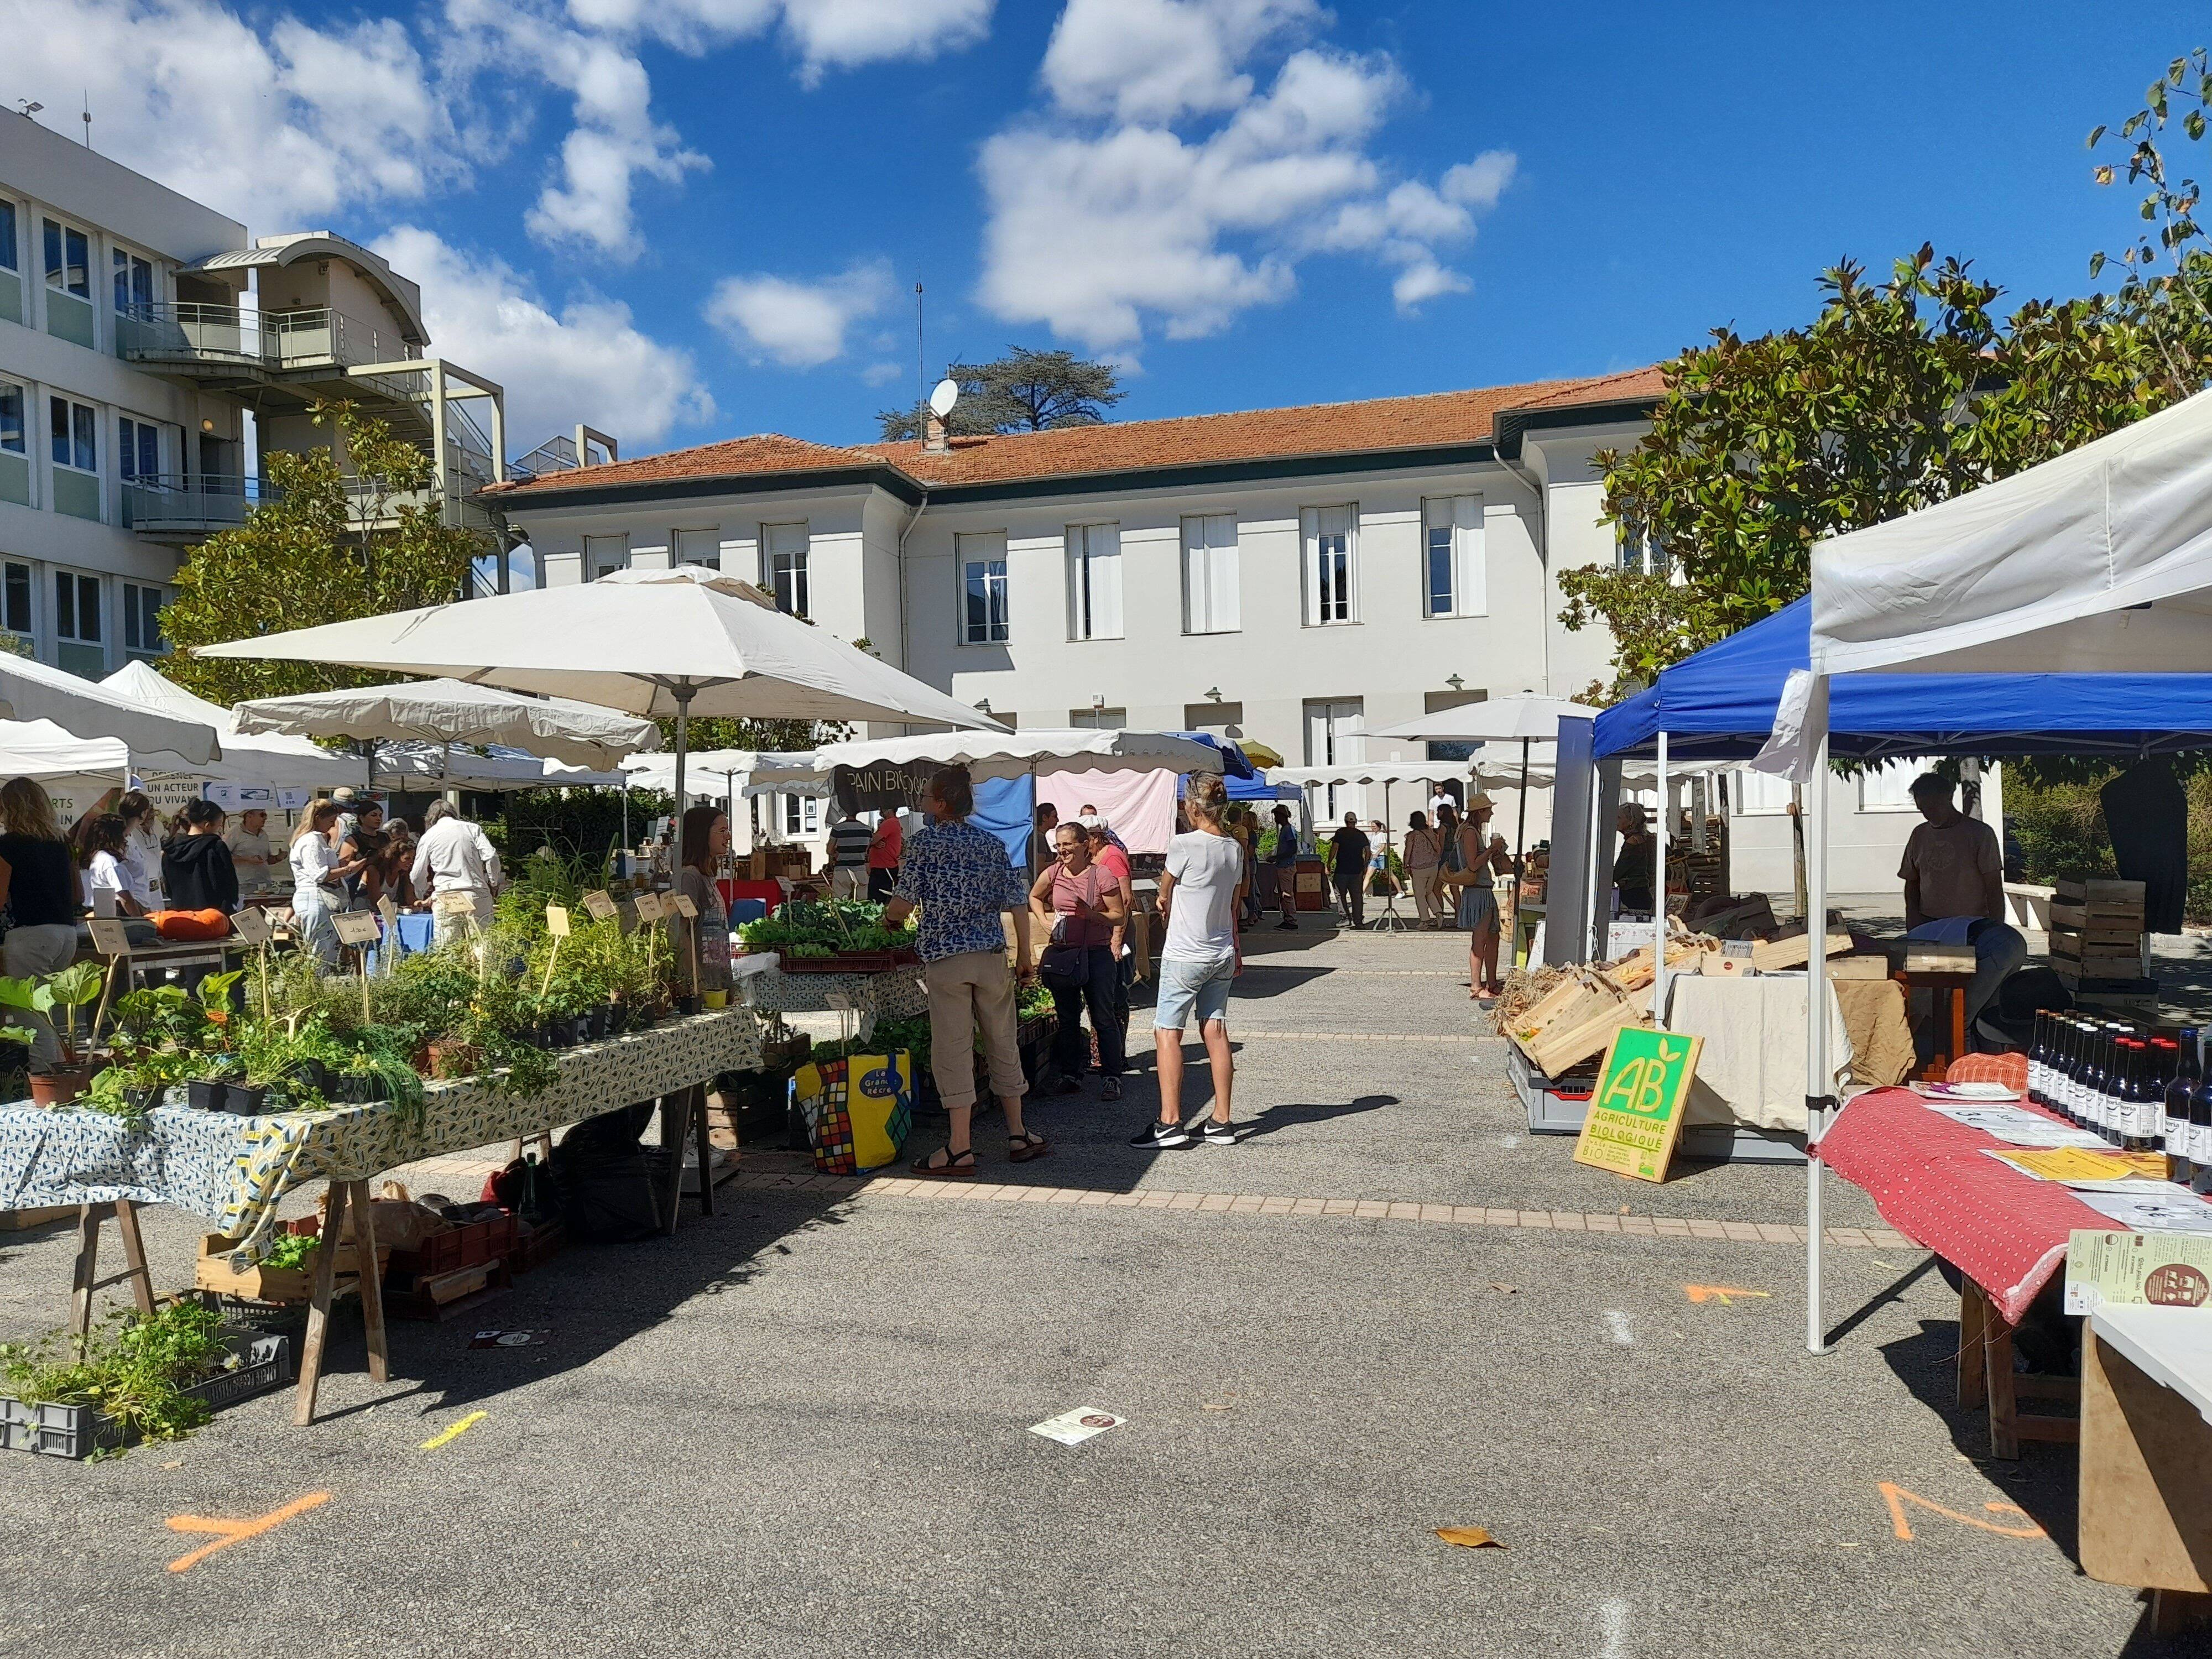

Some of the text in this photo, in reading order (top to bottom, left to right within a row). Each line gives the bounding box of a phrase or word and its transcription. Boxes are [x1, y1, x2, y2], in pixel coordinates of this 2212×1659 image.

[147, 783, 199, 792] UN ACTEUR
[847, 770, 881, 793] PAIN
[164, 795, 199, 804] VIVA
[1603, 1056, 1667, 1113] AB
[1593, 1110, 1667, 1135] AGRICULTURE
[1590, 1124, 1663, 1149] BIOLOGIQUE
